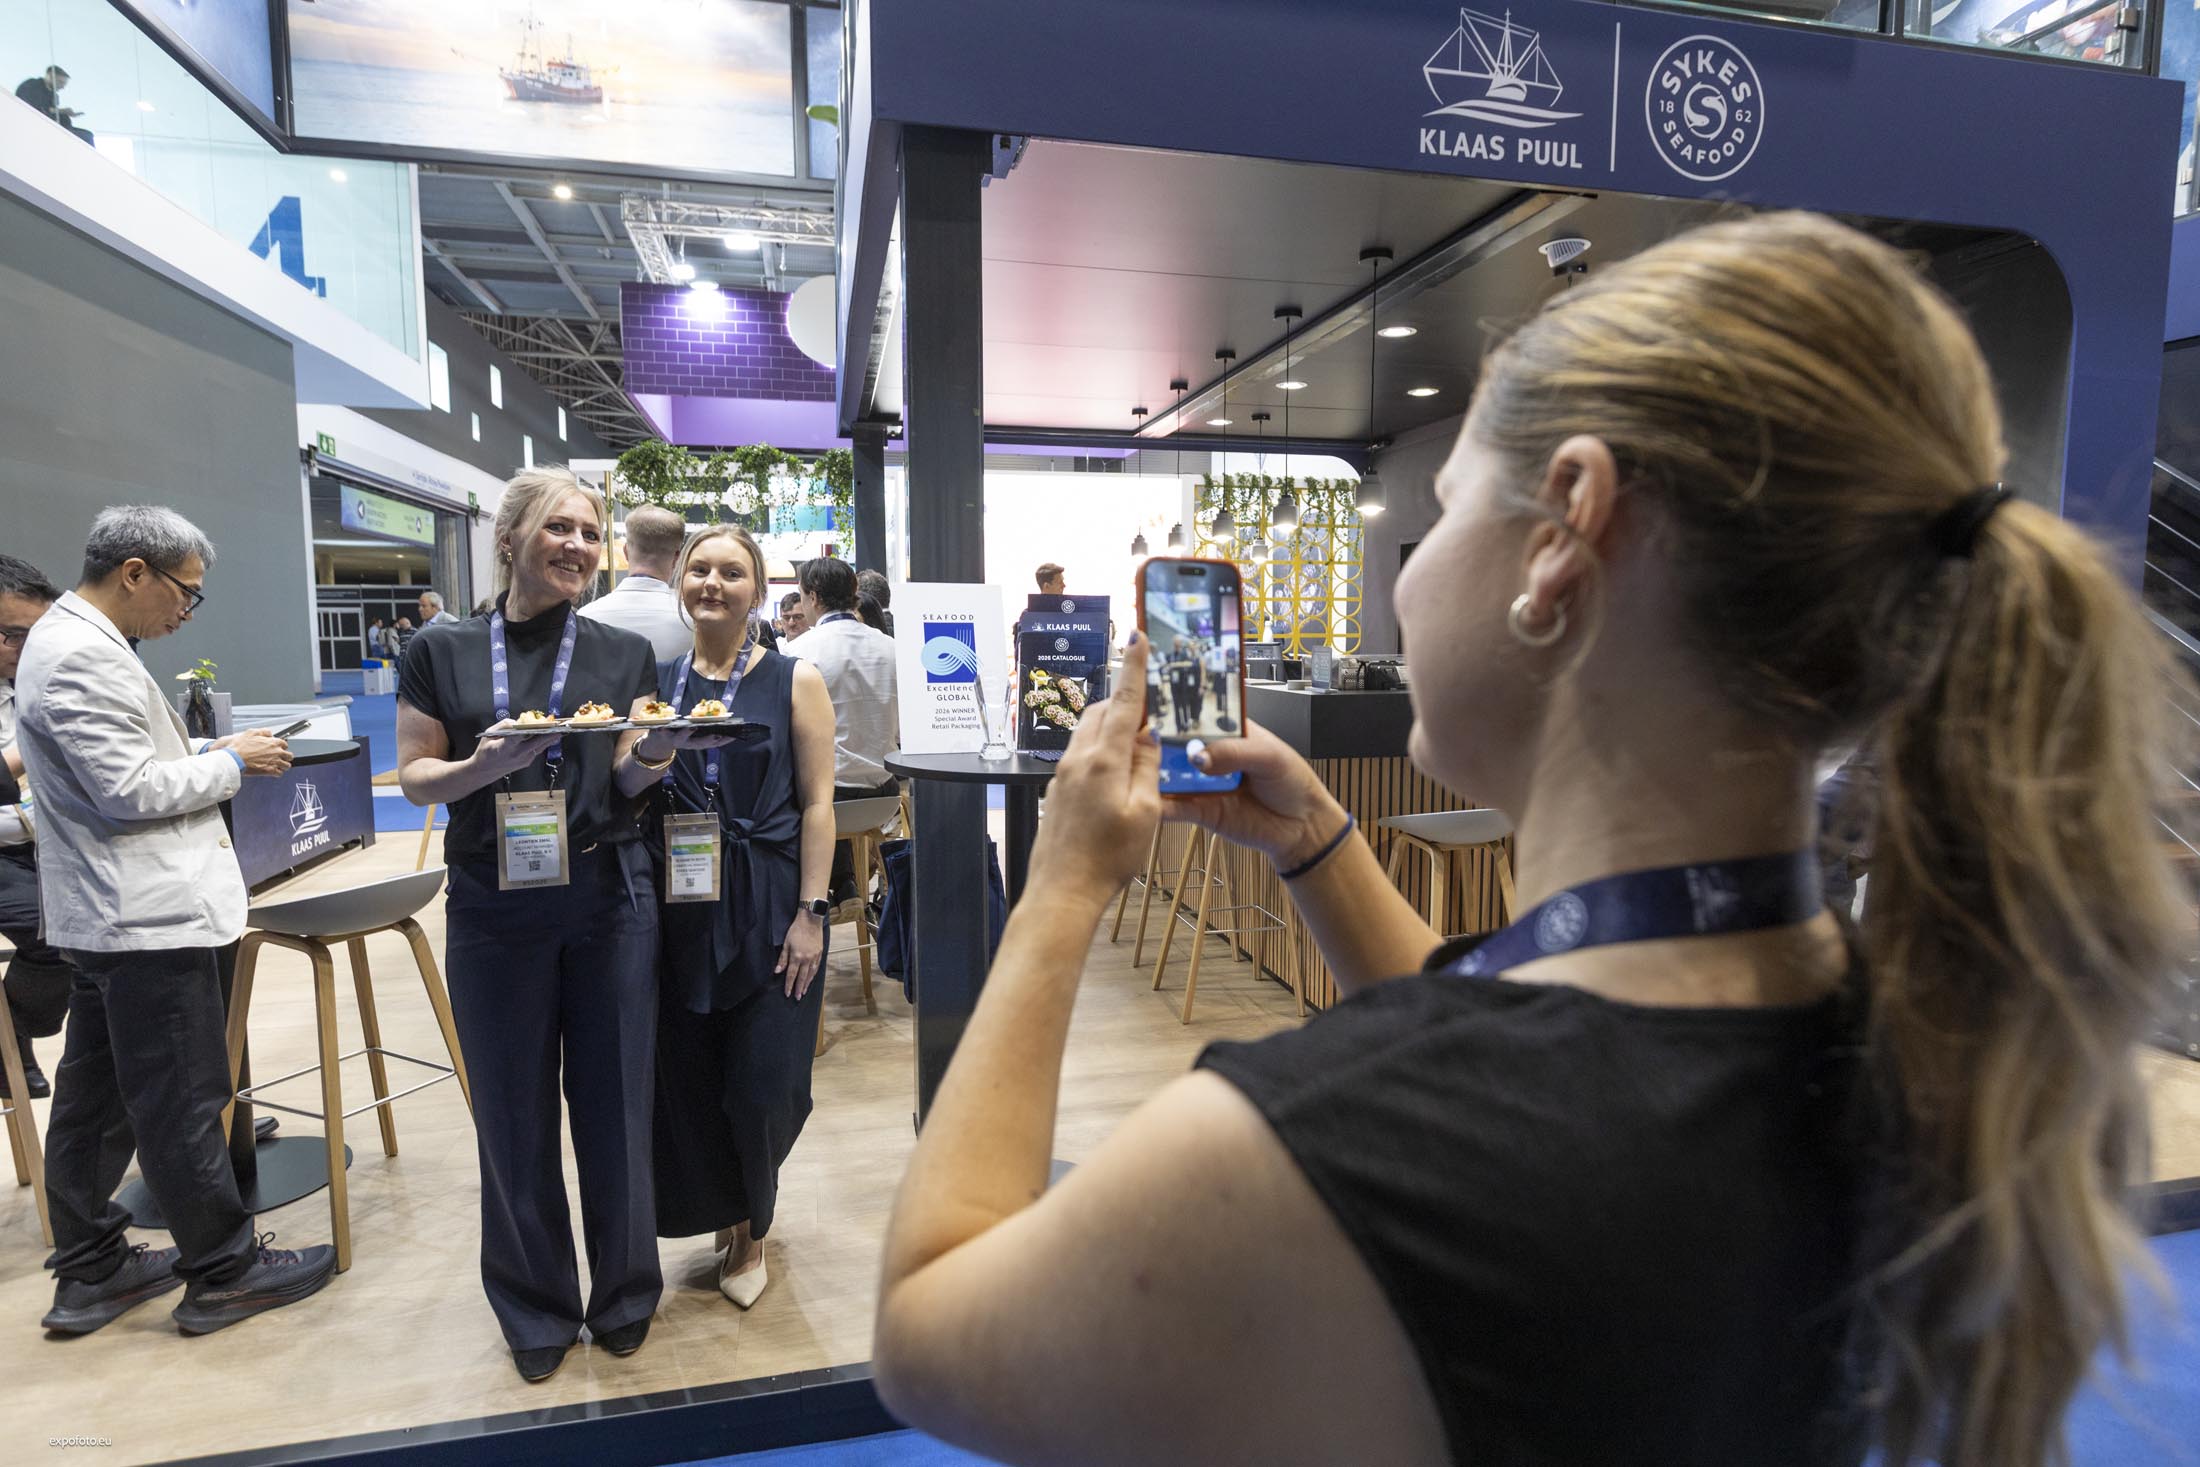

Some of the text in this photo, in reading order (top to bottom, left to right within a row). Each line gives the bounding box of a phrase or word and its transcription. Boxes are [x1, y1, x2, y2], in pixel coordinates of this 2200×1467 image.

[1661, 50, 1752, 104] SYKES
[1659, 99, 1752, 124] 18 62
[1419, 128, 1582, 169] KLAAS PUUL
[1663, 120, 1745, 165] SEAFOOD
[1046, 623, 1092, 631] KLAAS PUUL
[291, 830, 331, 857] KLAAS PUUL
